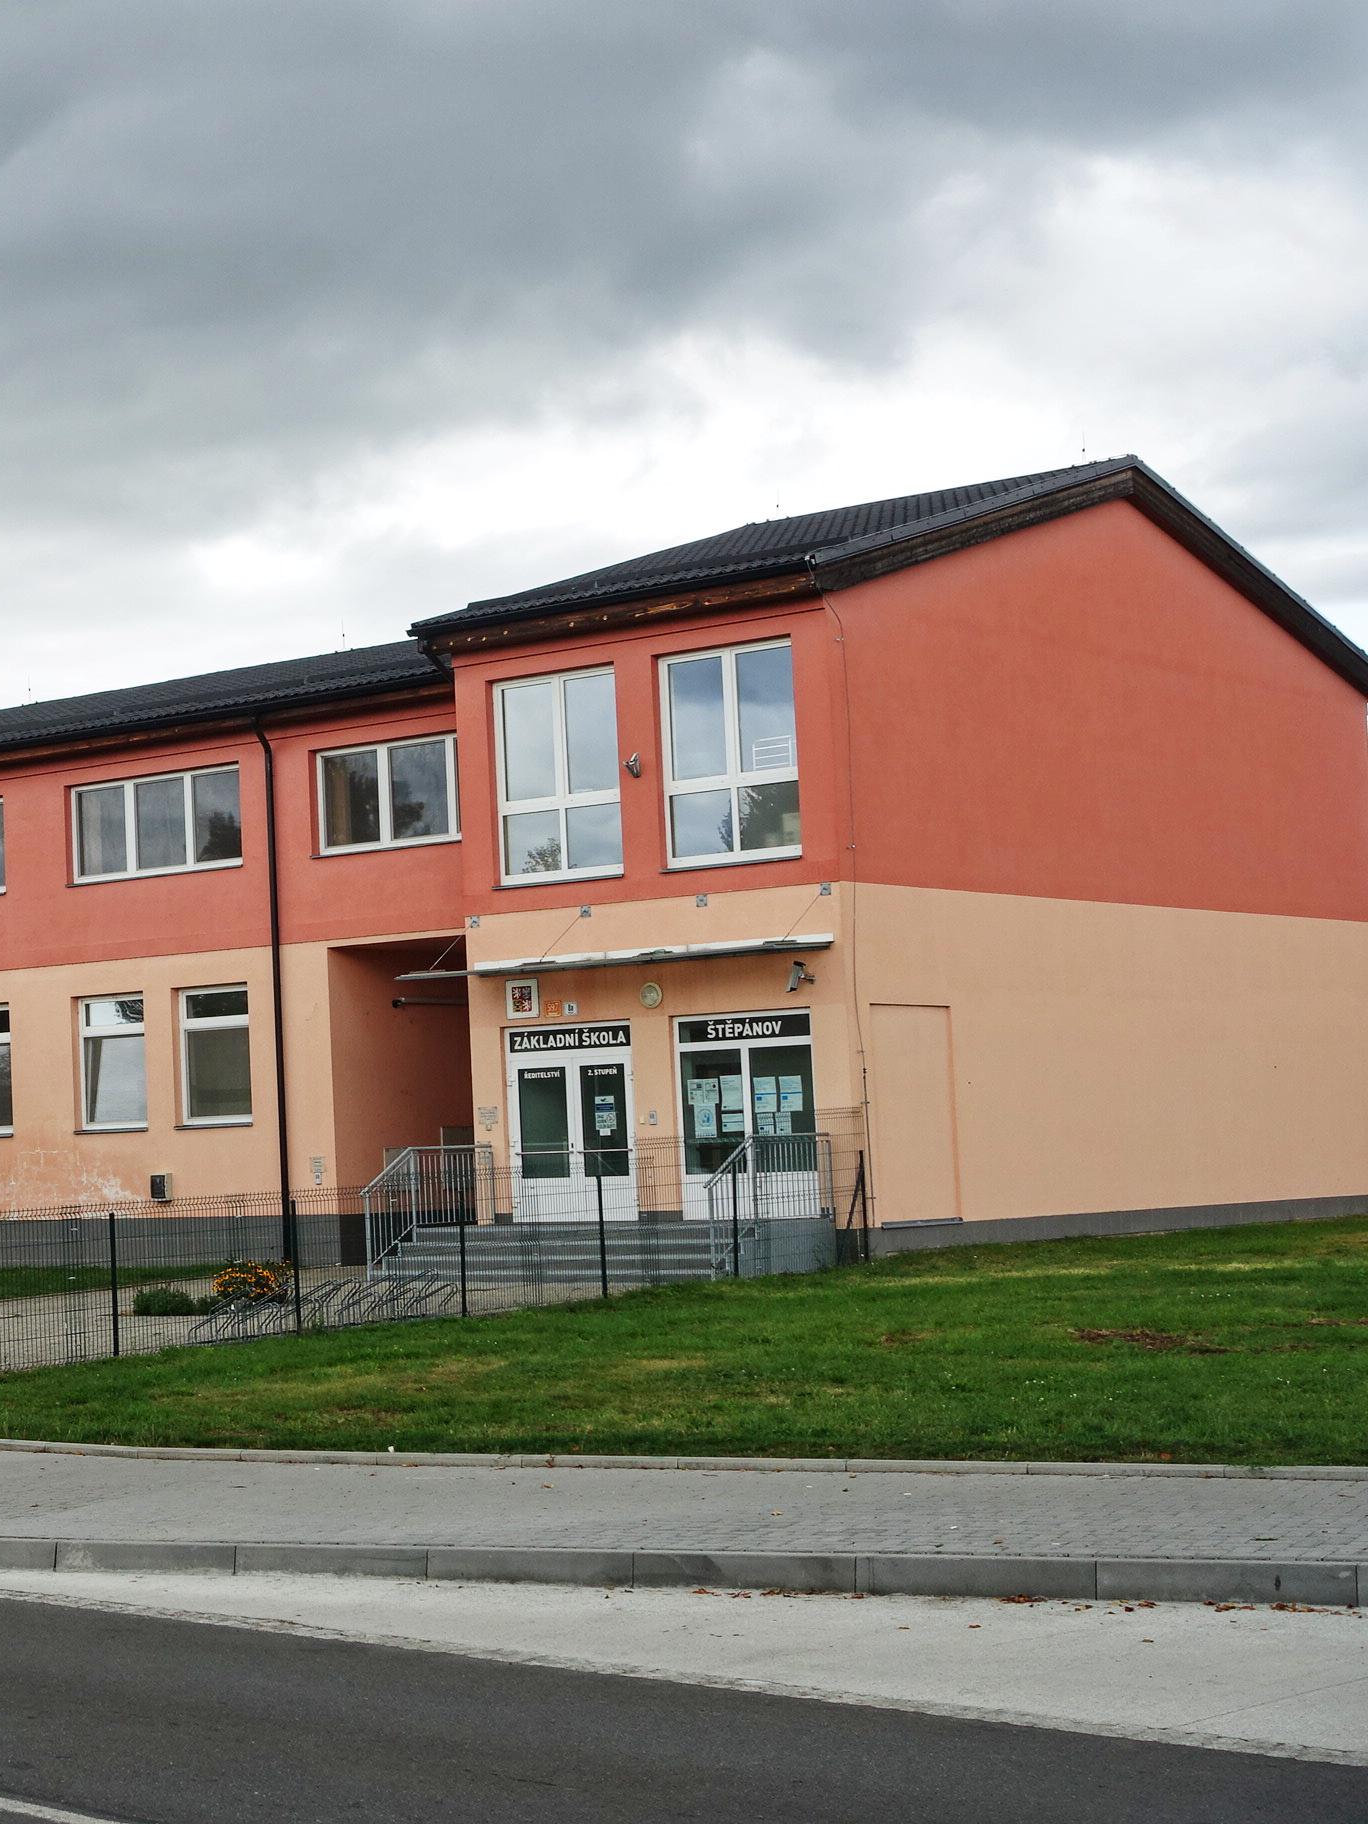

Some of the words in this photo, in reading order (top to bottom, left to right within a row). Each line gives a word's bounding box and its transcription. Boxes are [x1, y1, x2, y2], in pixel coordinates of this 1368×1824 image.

[707, 1019, 782, 1038] ŠTĚPÁNOV
[514, 1029, 579, 1049] ZÁKLADNÍ
[582, 1028, 626, 1046] ŠKOLA
[524, 1070, 561, 1079] ŘEDITELSTVÍ
[594, 1066, 618, 1075] STUPEŇ
